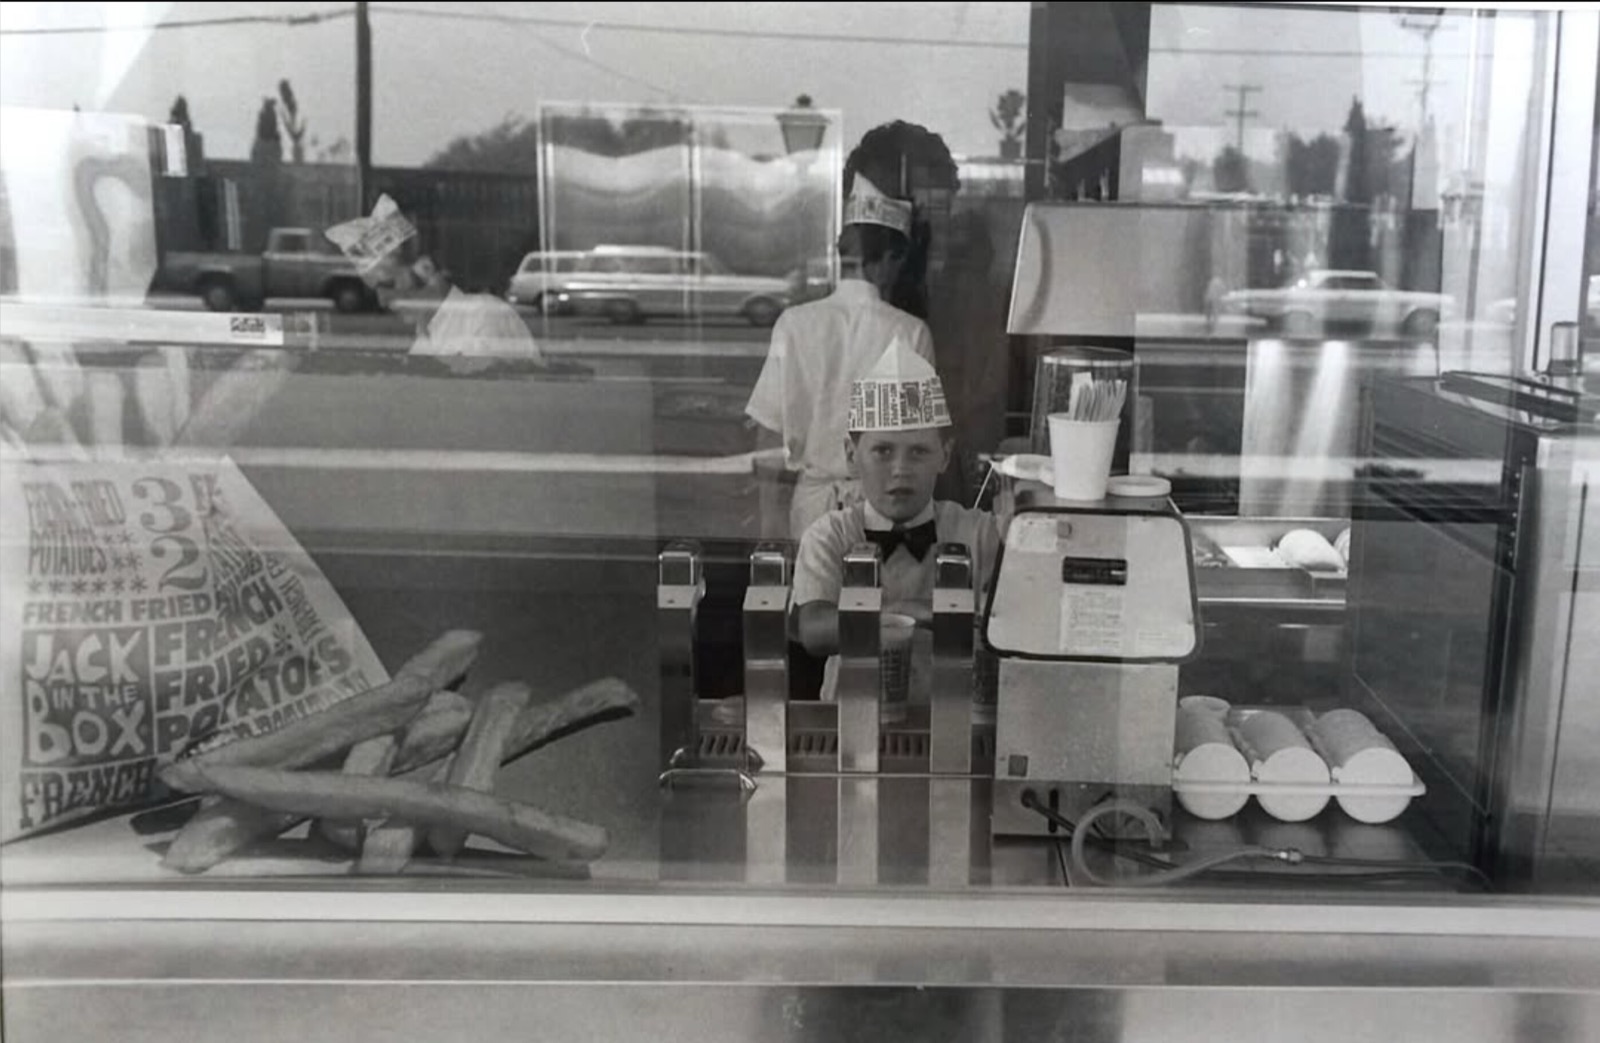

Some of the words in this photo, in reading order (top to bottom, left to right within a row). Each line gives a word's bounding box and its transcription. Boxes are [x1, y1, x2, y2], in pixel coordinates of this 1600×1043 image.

[131, 477, 192, 533] 3
[150, 535, 209, 592] 2
[24, 600, 122, 624] FRENCH
[131, 592, 212, 620] FRIED
[26, 630, 143, 686] JACK
[154, 636, 271, 713] FRIED
[26, 679, 146, 764] BOX
[52, 687, 74, 710] IN
[79, 684, 139, 709] THE
